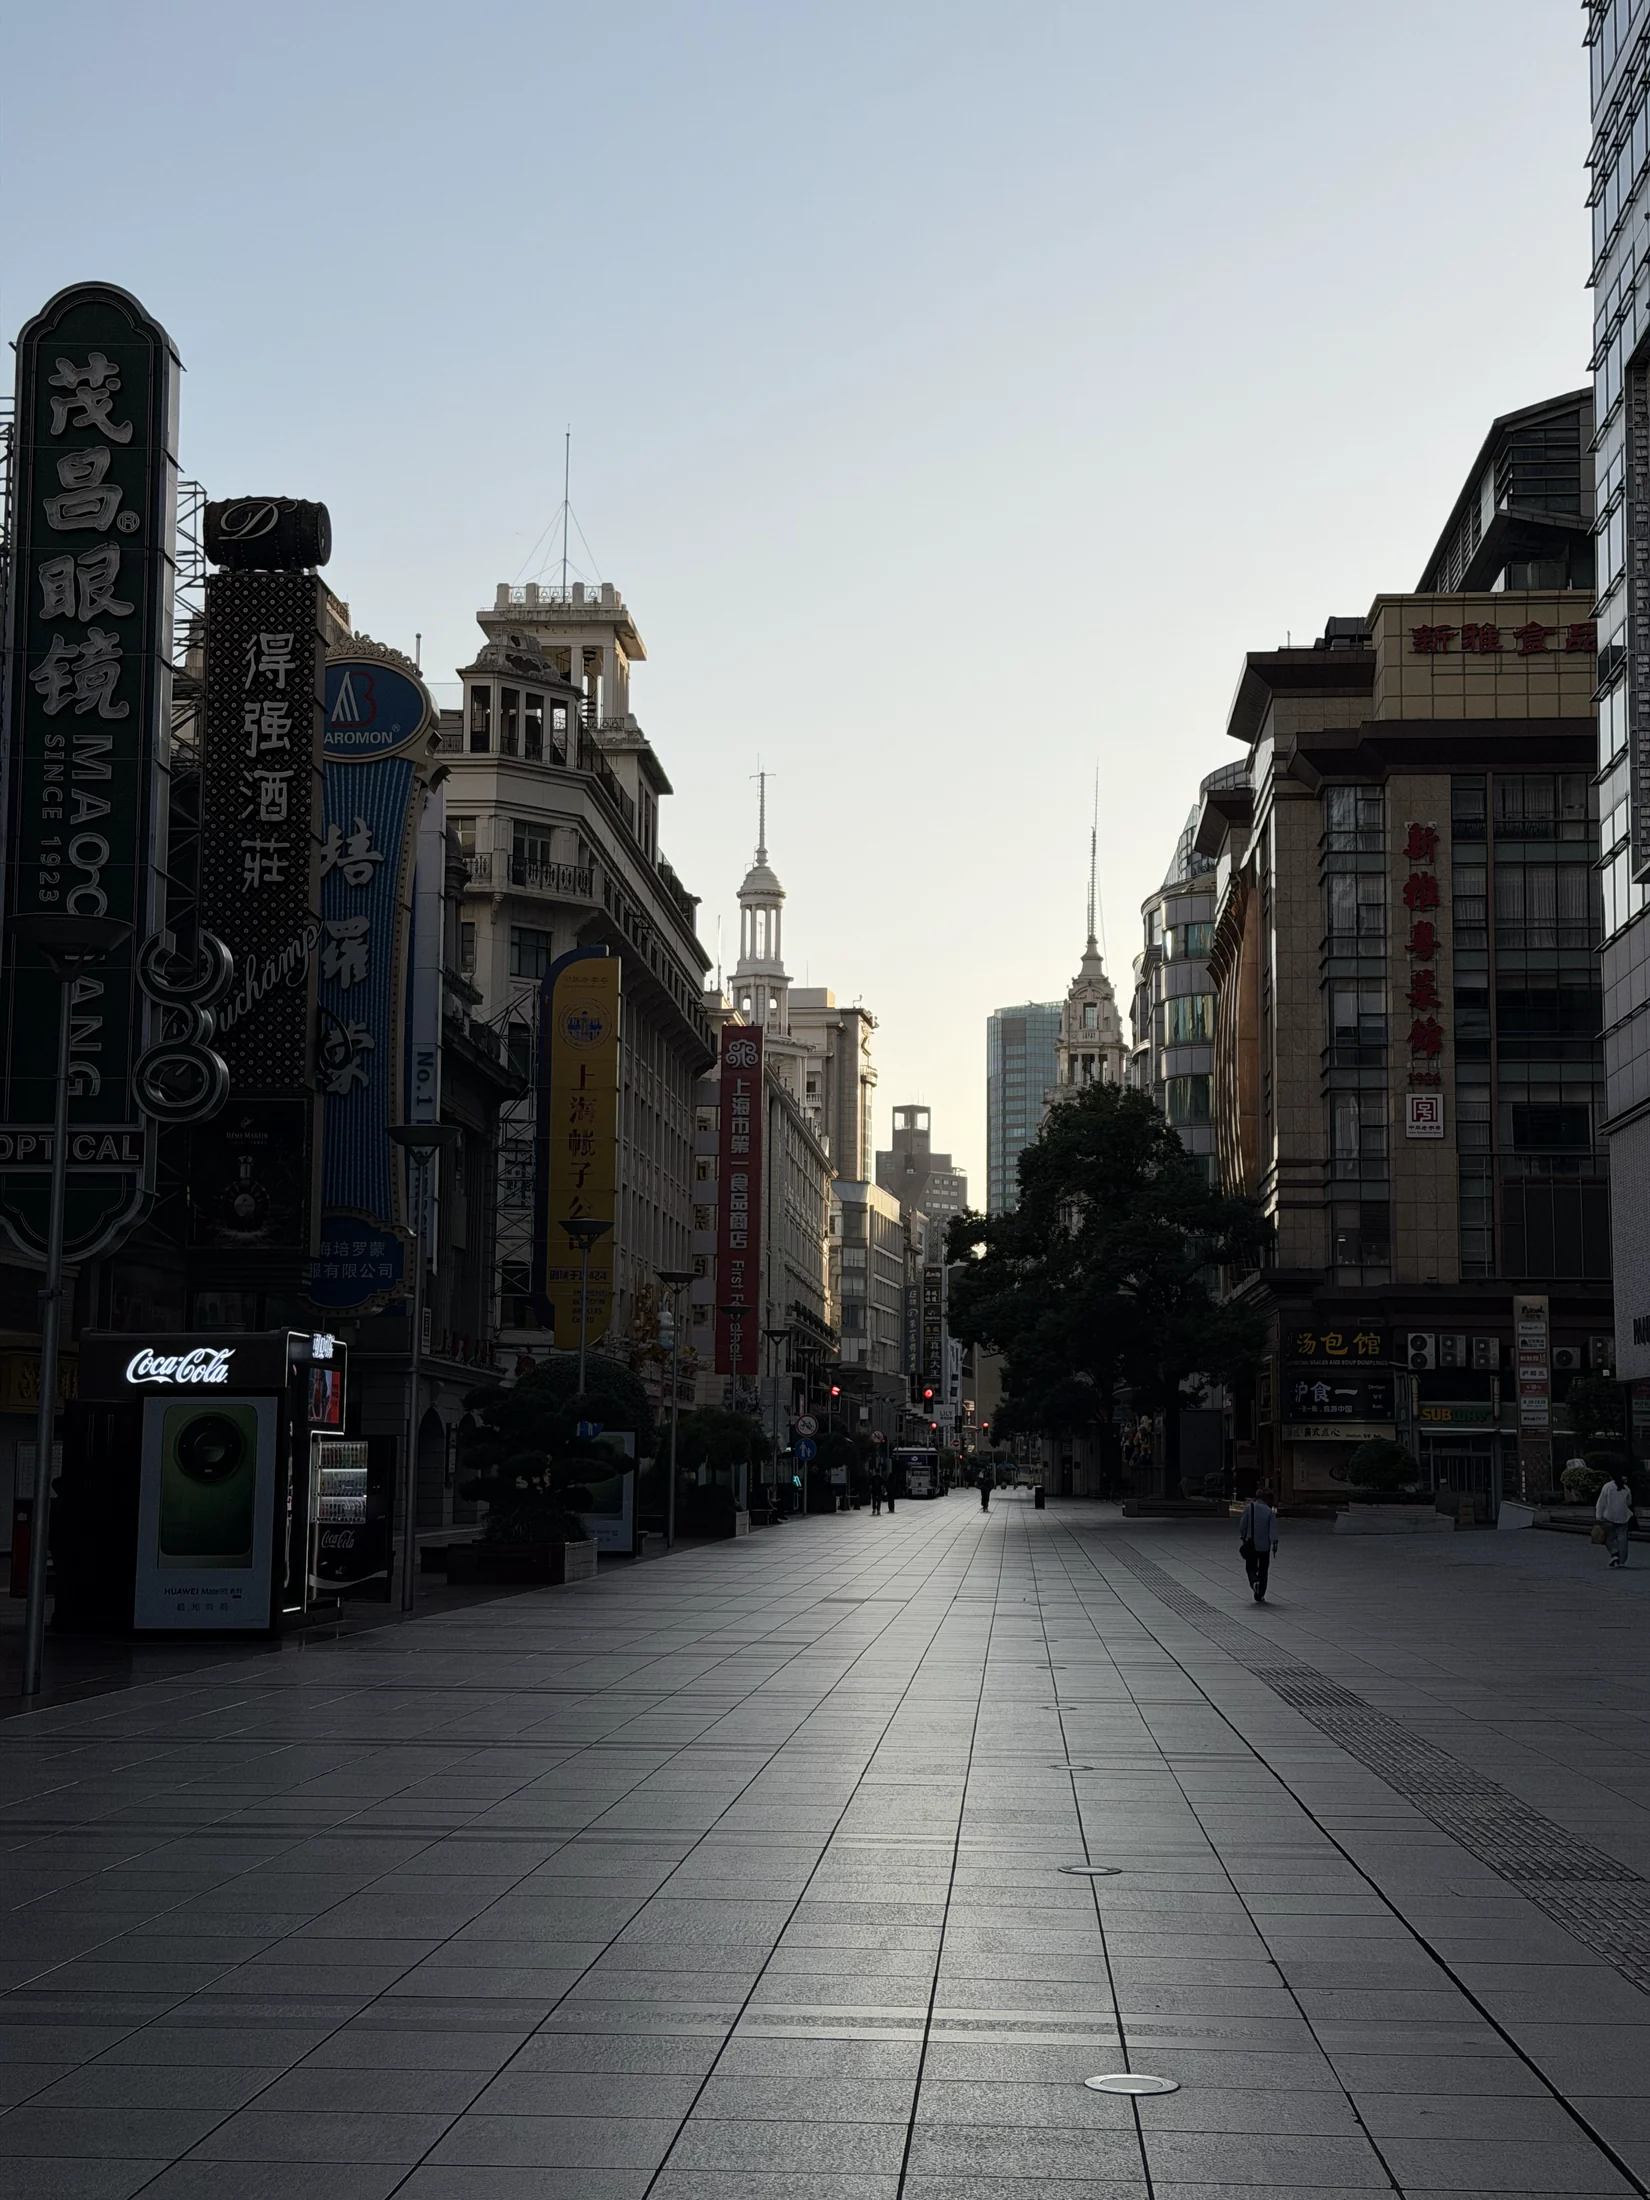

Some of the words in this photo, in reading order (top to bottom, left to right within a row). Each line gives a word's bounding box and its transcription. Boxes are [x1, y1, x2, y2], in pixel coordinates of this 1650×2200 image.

[42, 733, 65, 820] SINCE
[38, 835, 62, 903] 1923
[66, 734, 113, 1096] MAOCANG
[219, 920, 325, 1033] uchamp
[416, 1051, 434, 1106] No.1
[0, 1134, 140, 1161] OPTCAL
[728, 1078, 752, 1250] 上海市第一食品商店
[731, 1259, 745, 1289] First
[929, 1341, 941, 1377] 真丝大王
[1296, 1331, 1382, 1356] 汤包馆
[125, 1347, 237, 1385] Coca-Cola
[1420, 1407, 1492, 1422] SUBWAY
[164, 1587, 199, 1595] HUAWEI
